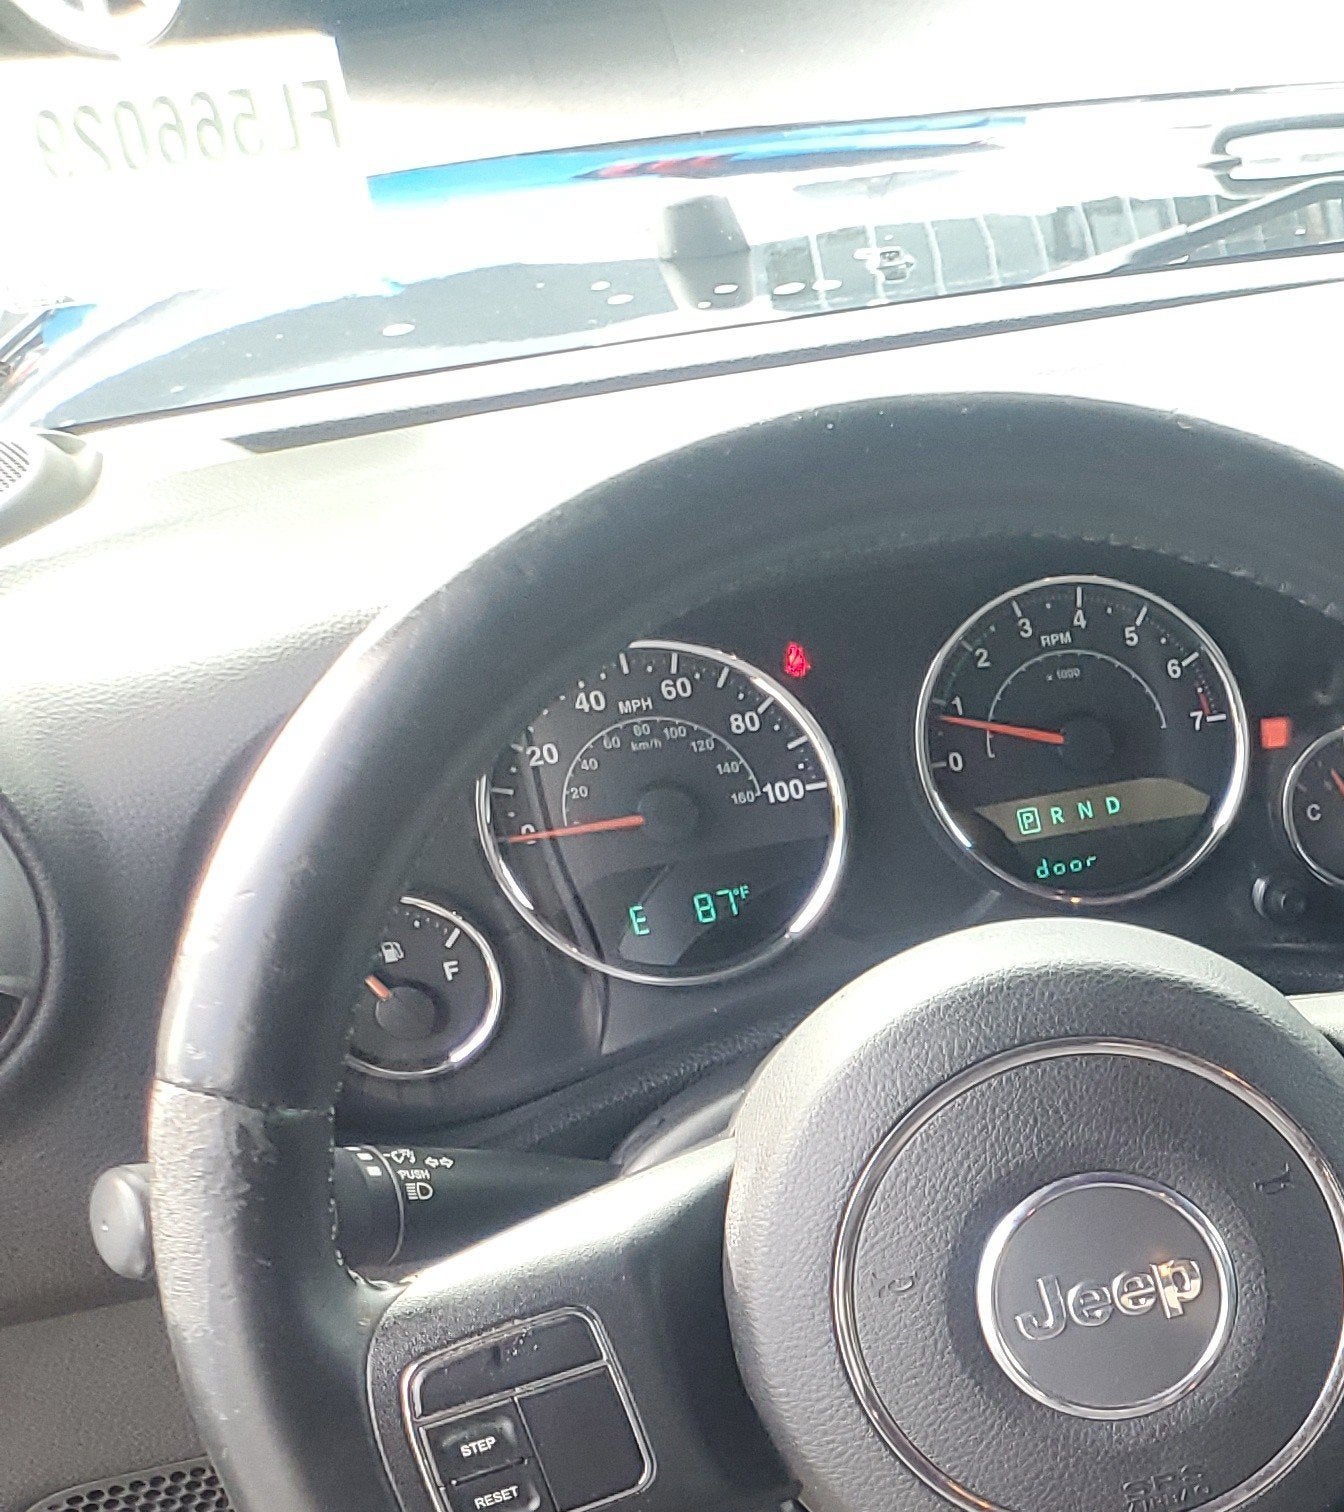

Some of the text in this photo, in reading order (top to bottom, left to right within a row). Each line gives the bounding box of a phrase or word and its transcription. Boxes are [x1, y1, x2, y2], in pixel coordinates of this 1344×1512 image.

[1018, 618, 1033, 638] 3
[1073, 609, 1087, 630] 4
[1040, 631, 1072, 648] RPM
[1124, 626, 1138, 647] 5
[975, 649, 991, 669] 2
[1166, 658, 1182, 679] 6
[661, 676, 692, 701] 60
[574, 690, 606, 713] 40
[618, 697, 653, 715] MPH
[951, 696, 963, 716] 1
[729, 711, 760, 735] 80
[1190, 710, 1204, 731] 7
[663, 724, 687, 740] 100
[525, 742, 560, 768] 20
[630, 737, 662, 752] km/h
[691, 738, 715, 753] 120
[580, 757, 599, 772] 40
[716, 761, 740, 776] 140
[948, 752, 963, 772] 0
[570, 785, 589, 800] 20
[730, 790, 755, 806] 160
[762, 779, 806, 805] 100
[1050, 808, 1065, 826] R
[1078, 801, 1094, 820] N
[1106, 795, 1121, 815] D
[1307, 803, 1322, 822] C
[1036, 854, 1097, 879] door
[629, 905, 650, 936] E
[443, 960, 459, 981] F
[397, 1169, 431, 1180] PUSH
[1014, 1259, 1203, 1341] Jeep
[460, 1435, 496, 1458] STEP
[473, 1485, 519, 1510] RESET
